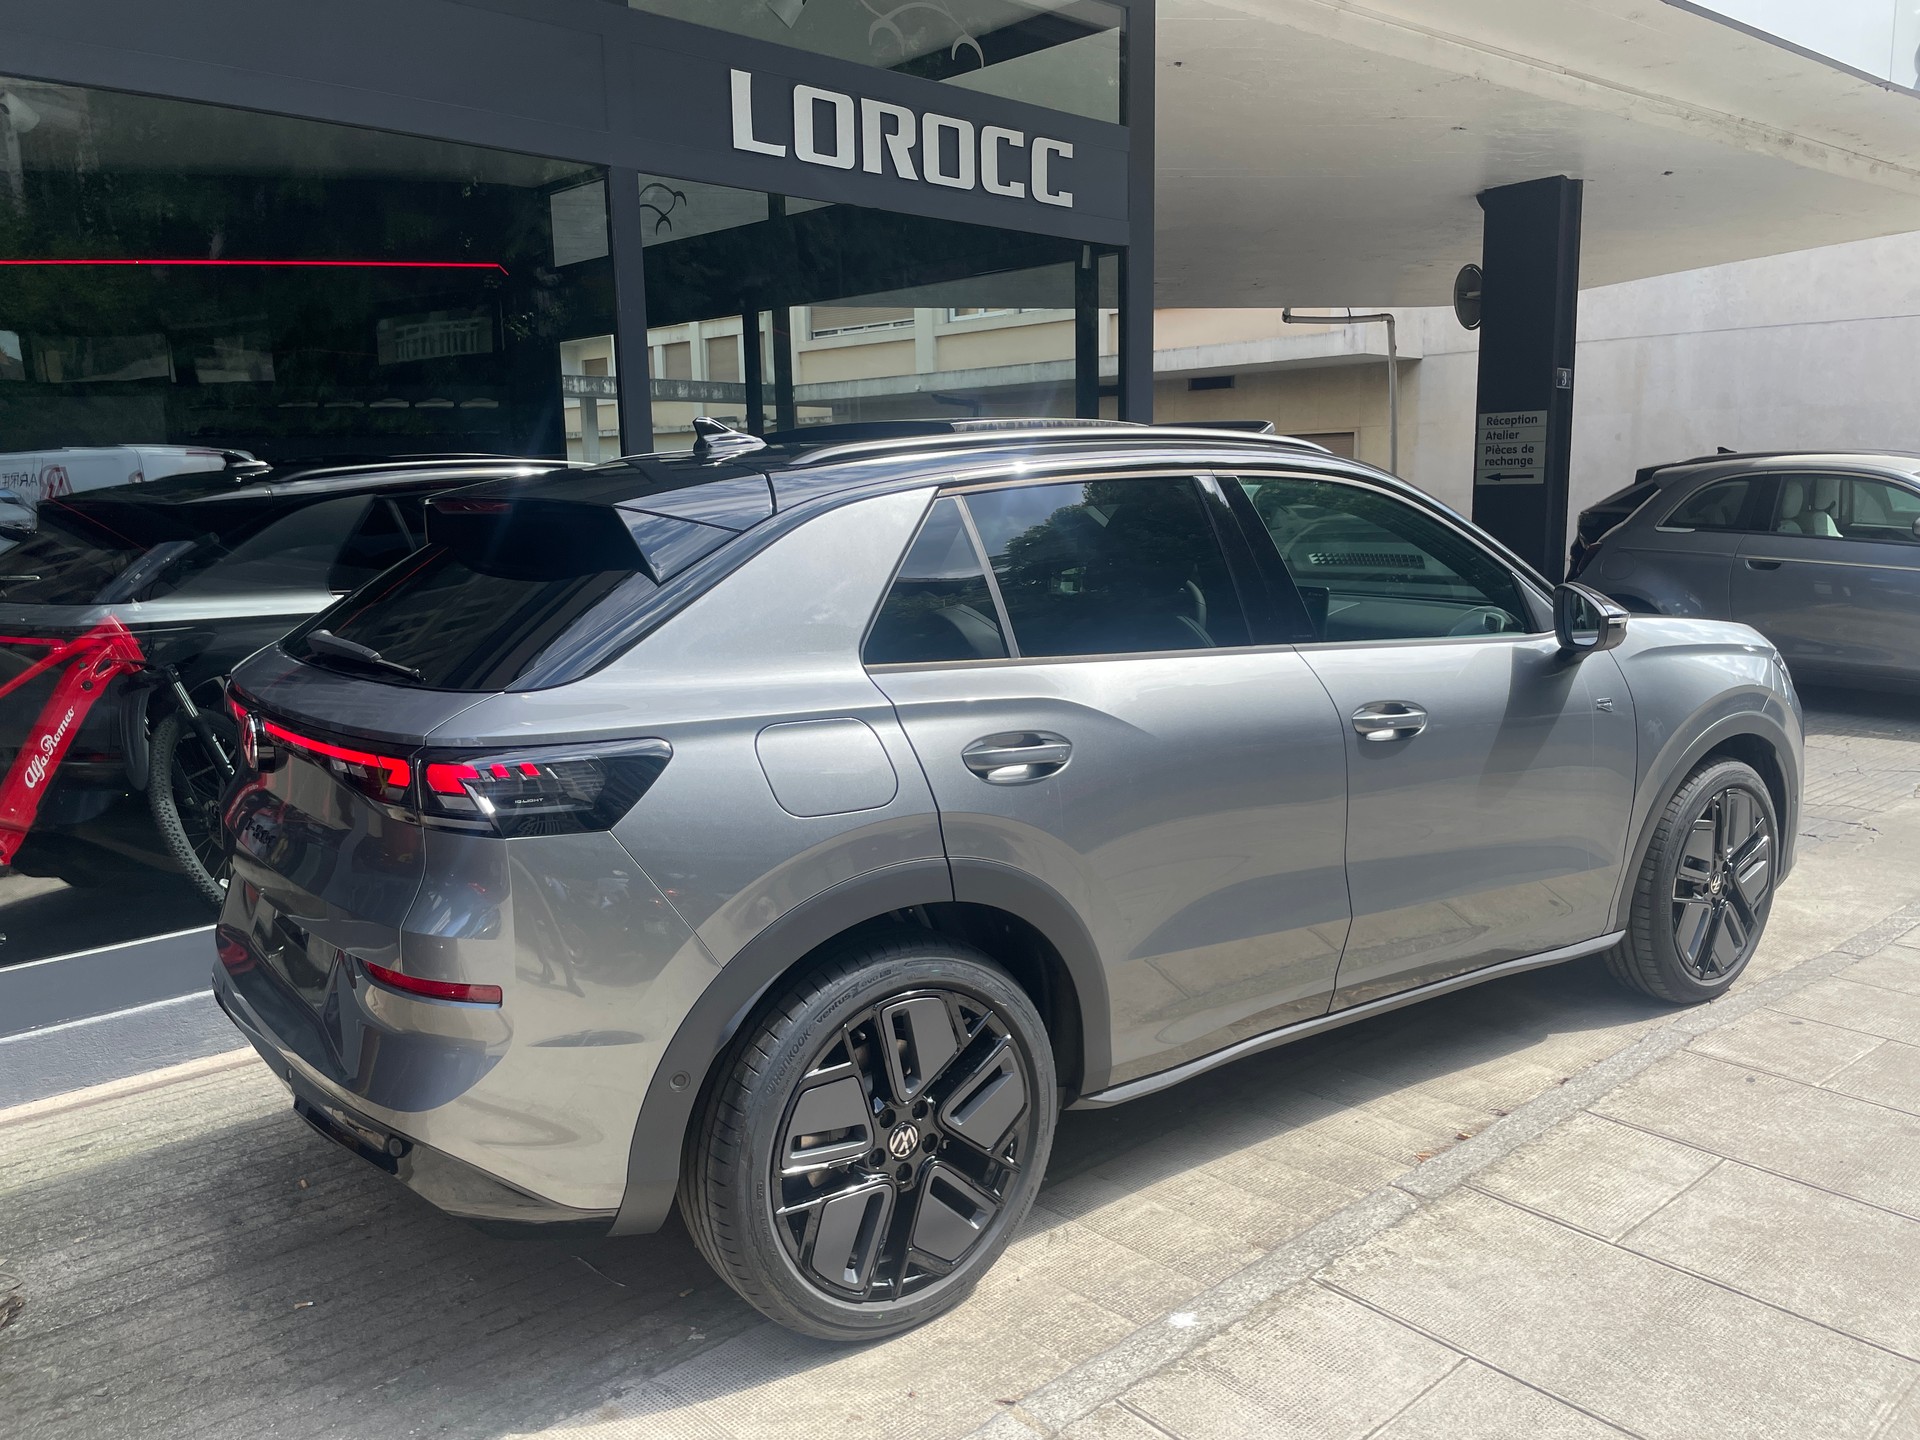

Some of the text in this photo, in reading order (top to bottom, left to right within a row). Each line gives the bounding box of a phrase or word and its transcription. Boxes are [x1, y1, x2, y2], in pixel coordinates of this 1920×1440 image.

[730, 68, 1074, 208] LOROCC
[1561, 370, 1567, 386] 3
[1486, 414, 1538, 427] Réception
[1485, 430, 1520, 441] Atelier
[1485, 443, 1535, 455] Pièces de
[1484, 456, 1534, 468] rechange
[24, 705, 75, 789] Alfa Romeo
